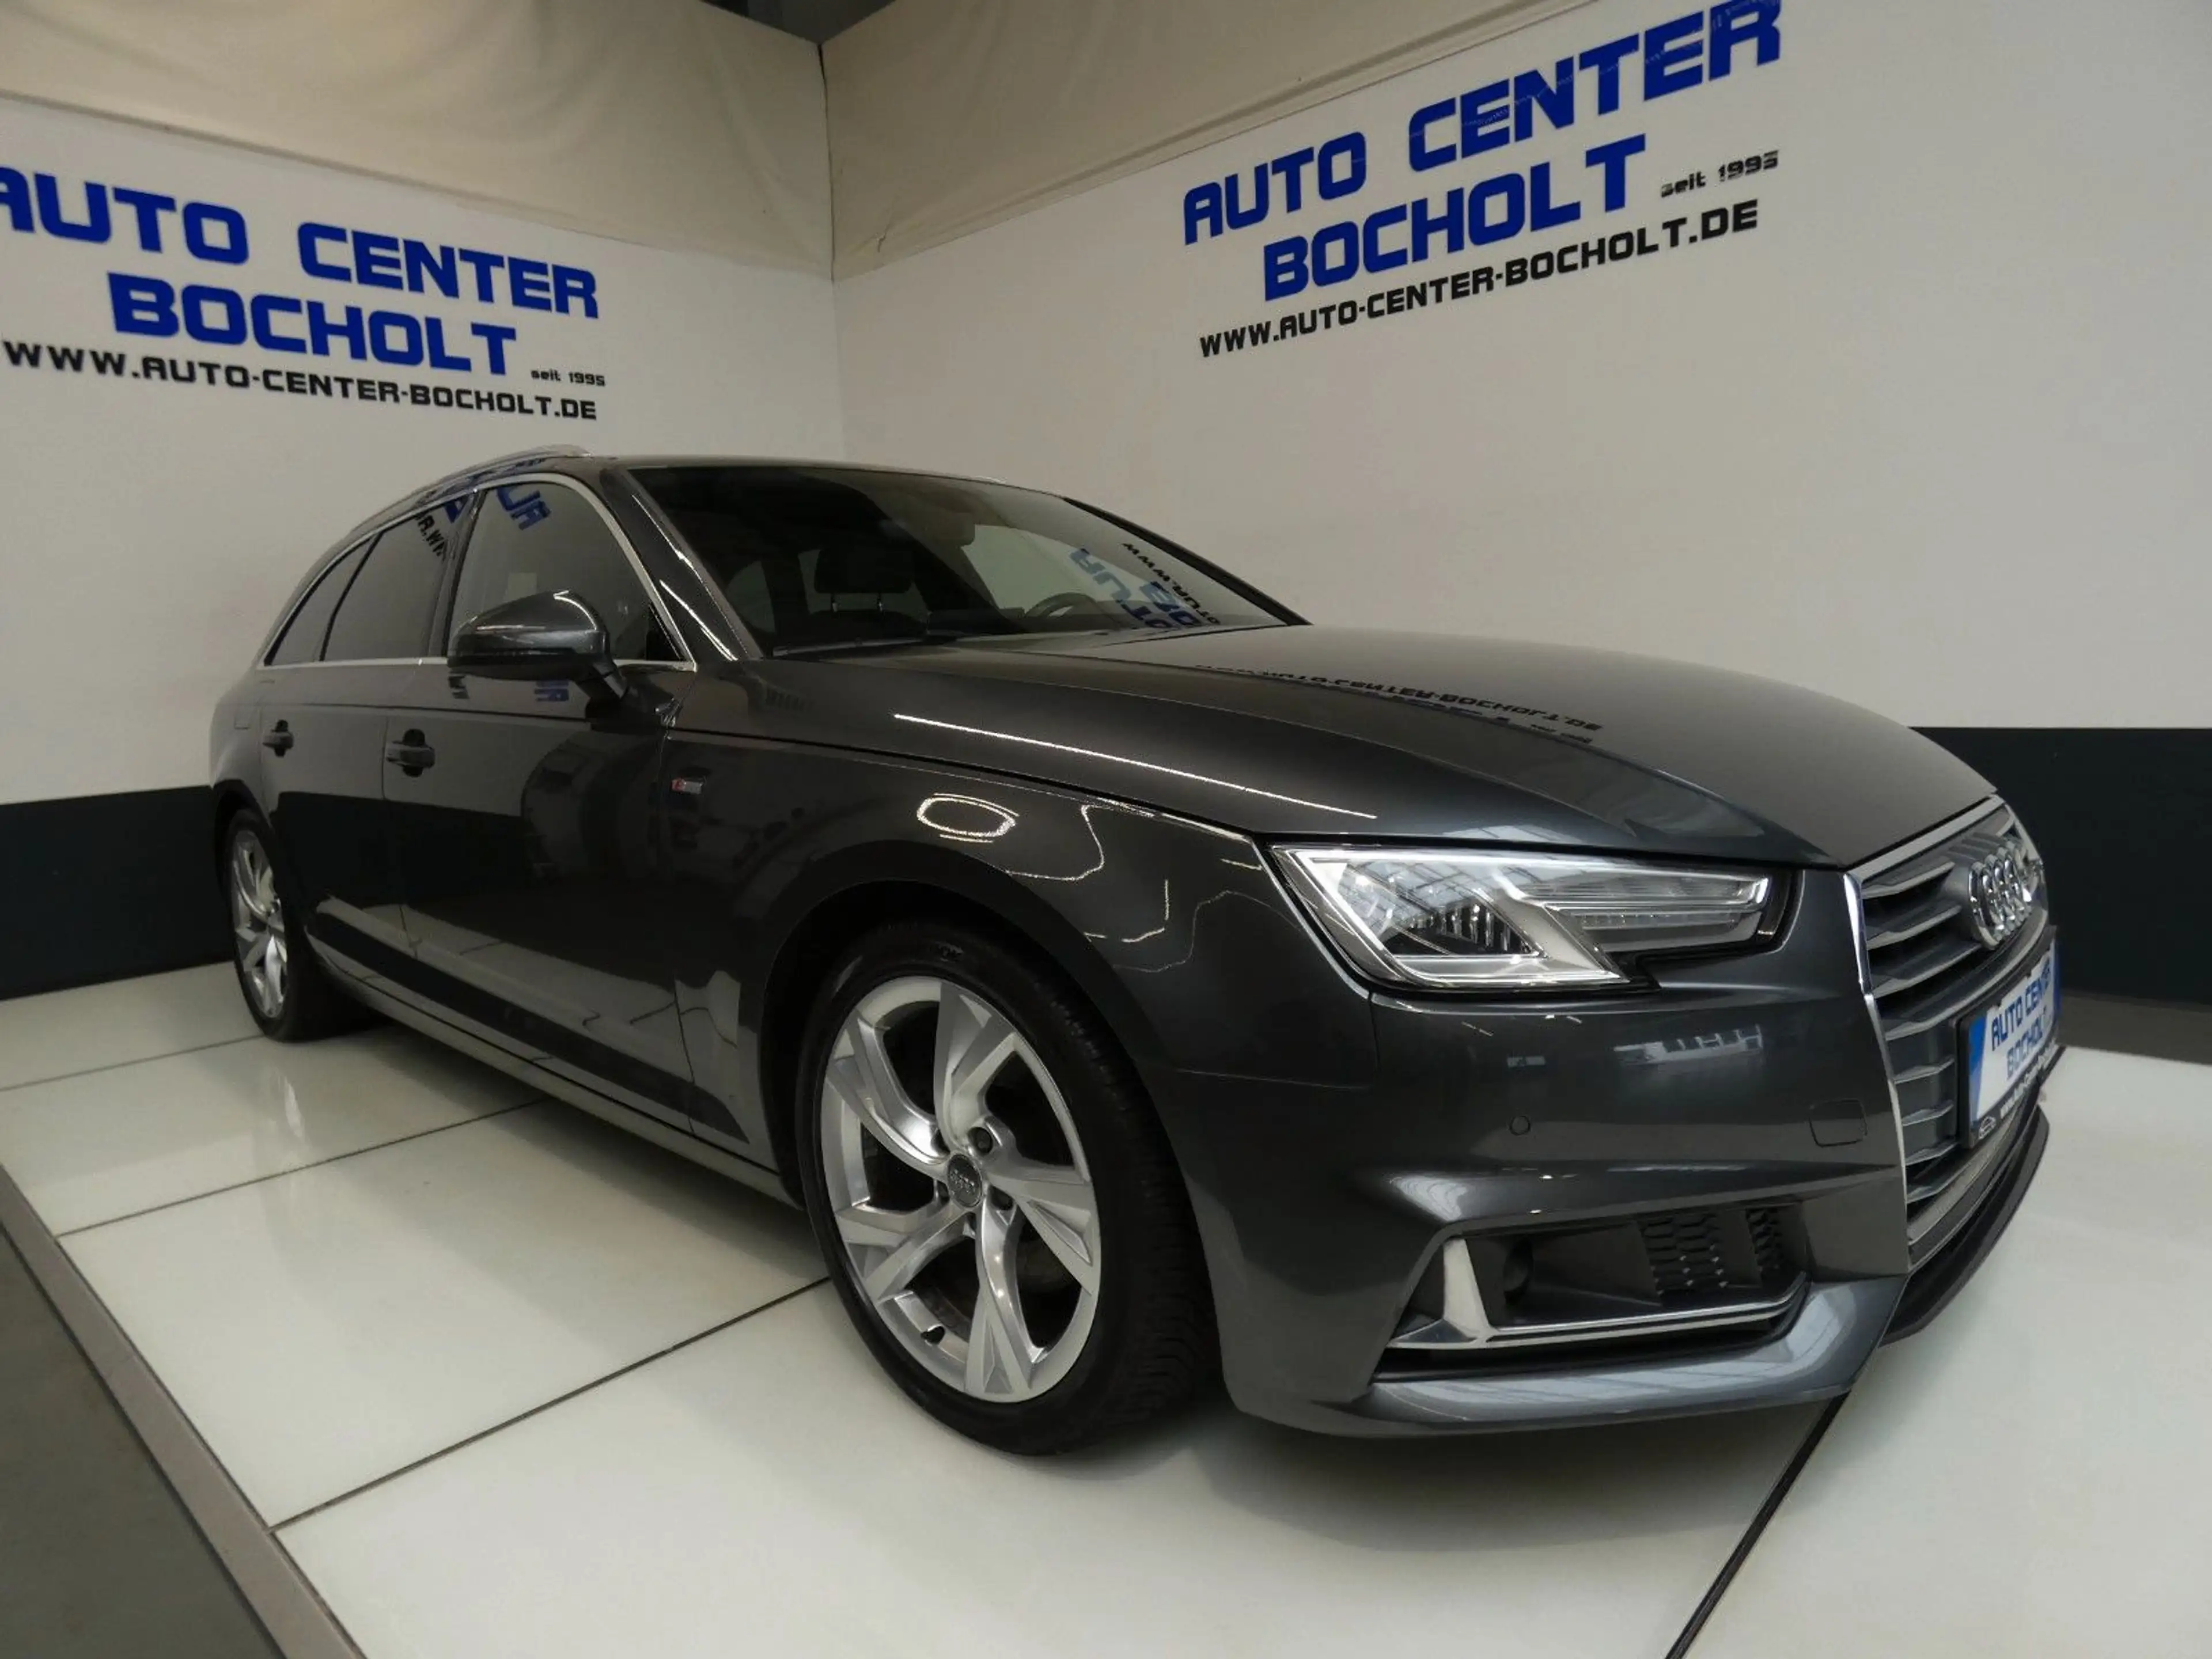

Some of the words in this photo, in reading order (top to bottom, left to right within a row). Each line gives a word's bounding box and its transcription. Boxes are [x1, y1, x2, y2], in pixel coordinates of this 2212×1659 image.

[1185, 133, 1367, 244] AUTO
[1409, 0, 1782, 171] CENTER
[298, 223, 599, 319] CENTER
[1265, 135, 1646, 300] BOCHOLT
[1661, 171, 1706, 198] seit
[1718, 150, 1778, 183] 1995
[108, 273, 516, 374] BOCHOLT
[531, 369, 561, 382] seit
[568, 372, 605, 387] 1995
[1200, 198, 1758, 358] WWW.AUTO-CENTER-BOCHOLT.DE
[3, 341, 597, 421] WWW.AUTO-CENTER-BOCHOLT.DE
[1992, 995, 2023, 1052] AUTO
